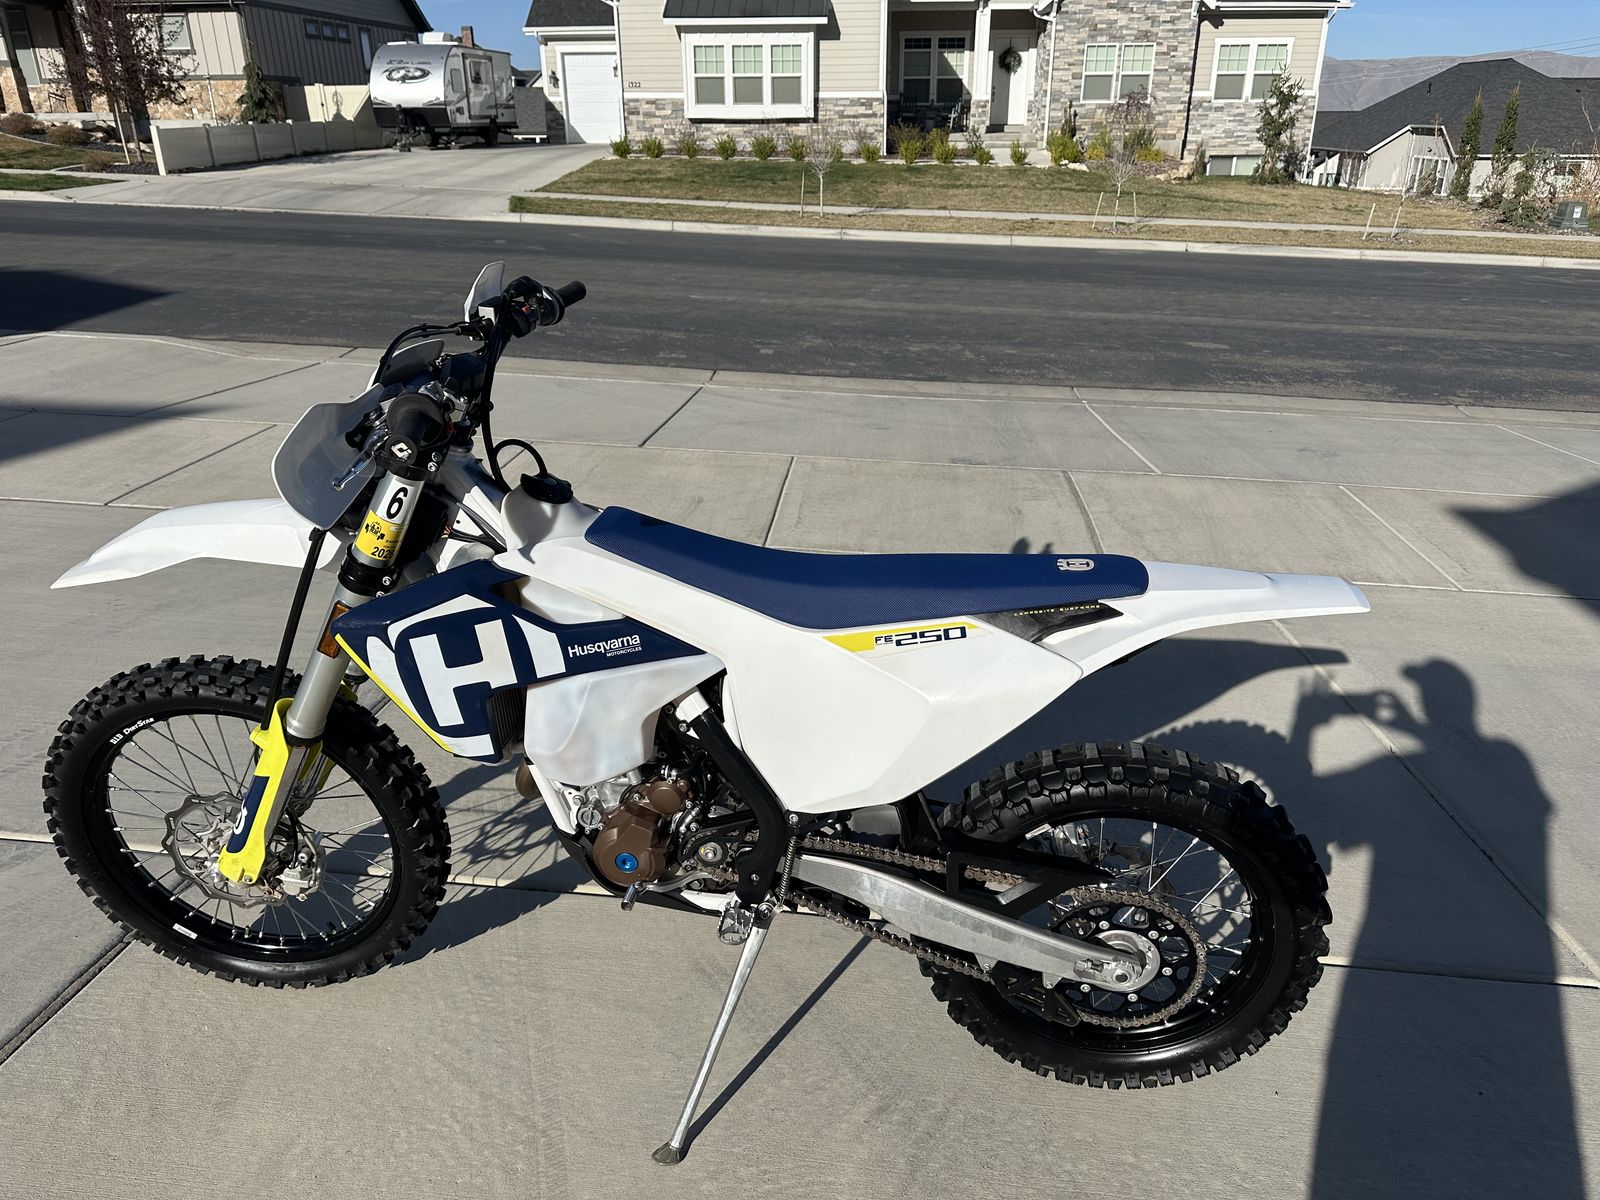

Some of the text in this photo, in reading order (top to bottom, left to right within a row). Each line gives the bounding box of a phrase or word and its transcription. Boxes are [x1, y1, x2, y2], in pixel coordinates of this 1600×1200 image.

[386, 486, 408, 519] 6
[568, 634, 641, 658] Husqvarna
[895, 626, 967, 647] 250
[606, 646, 642, 657] MOTORCYCLES
